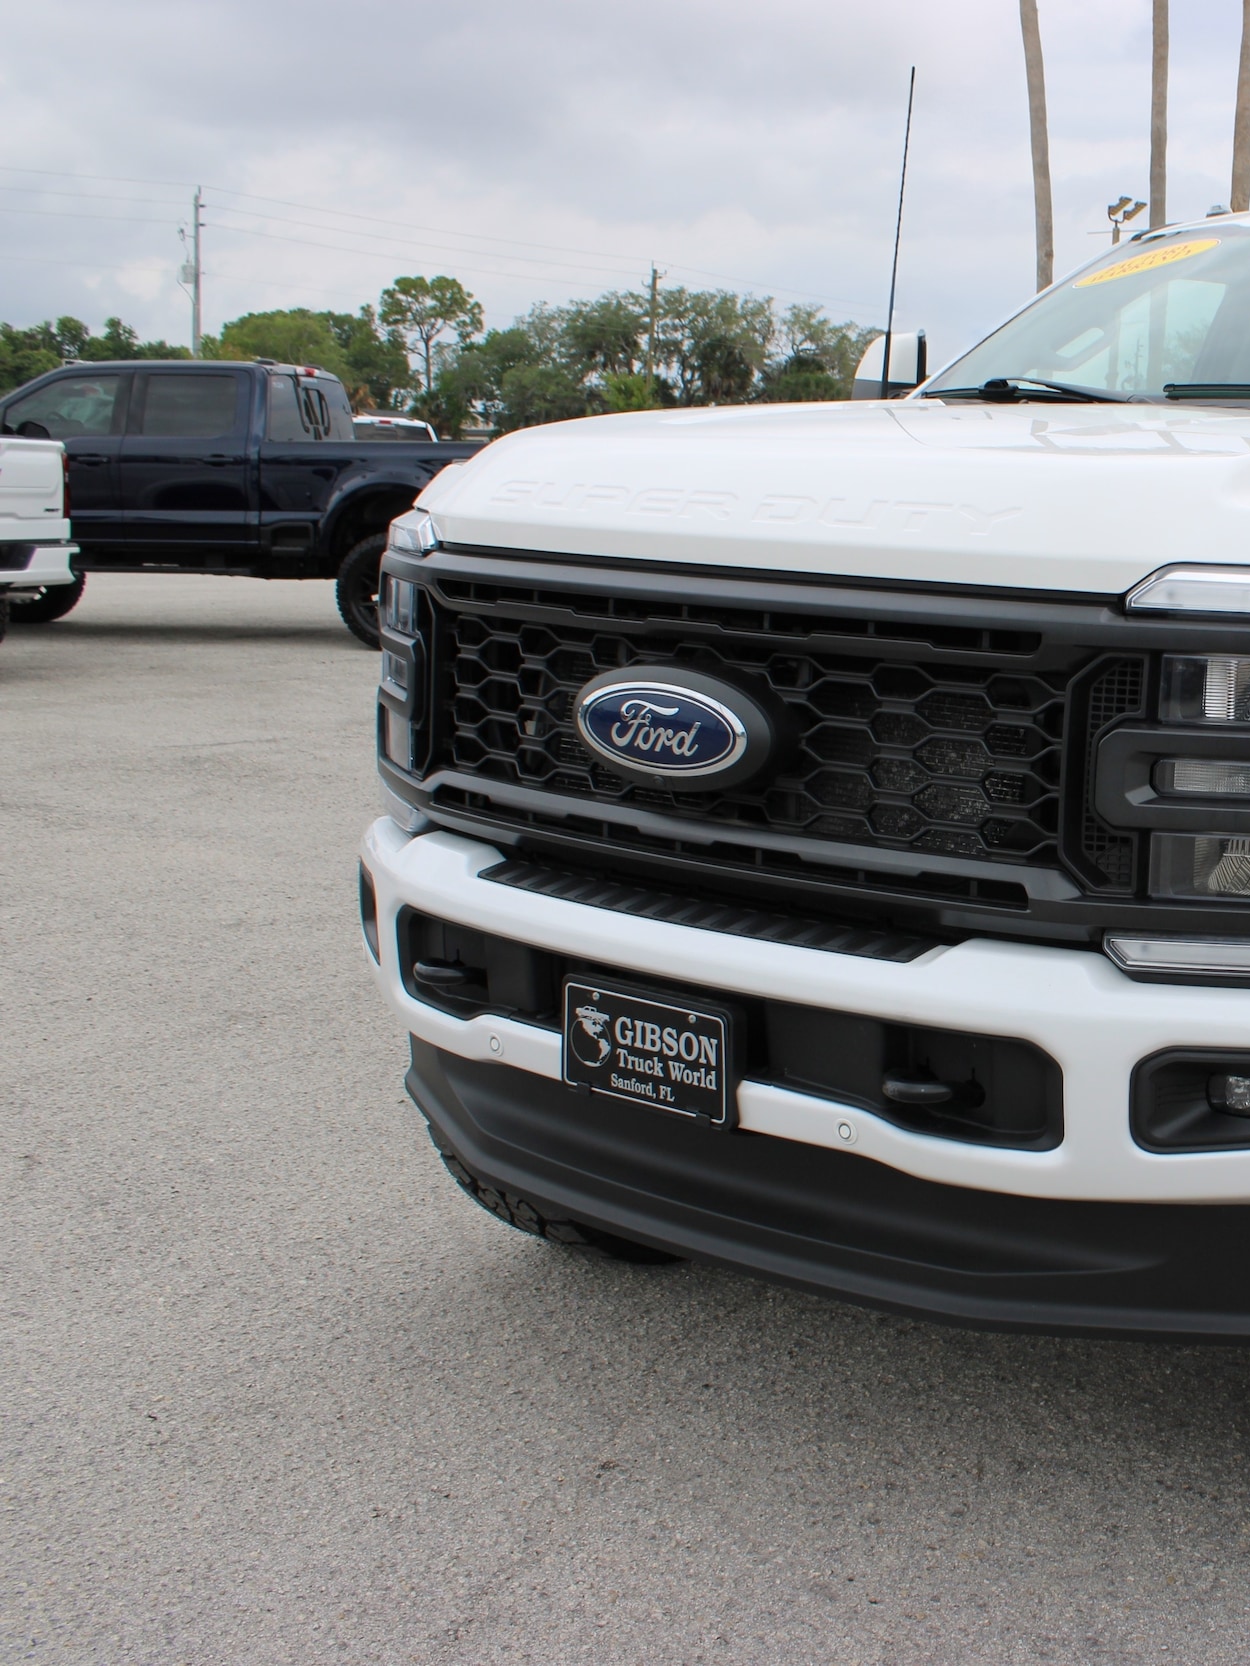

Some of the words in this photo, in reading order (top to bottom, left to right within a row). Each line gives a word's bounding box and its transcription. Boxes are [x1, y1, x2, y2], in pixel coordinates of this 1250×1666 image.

[488, 478, 740, 520] SUPER
[752, 491, 1023, 535] DUTY
[611, 699, 702, 757] Ford
[614, 1016, 718, 1067] GIBSON
[610, 1073, 657, 1100] Sanford,
[659, 1086, 675, 1102] FL
[616, 1048, 664, 1078] Truck
[668, 1060, 717, 1091] World
